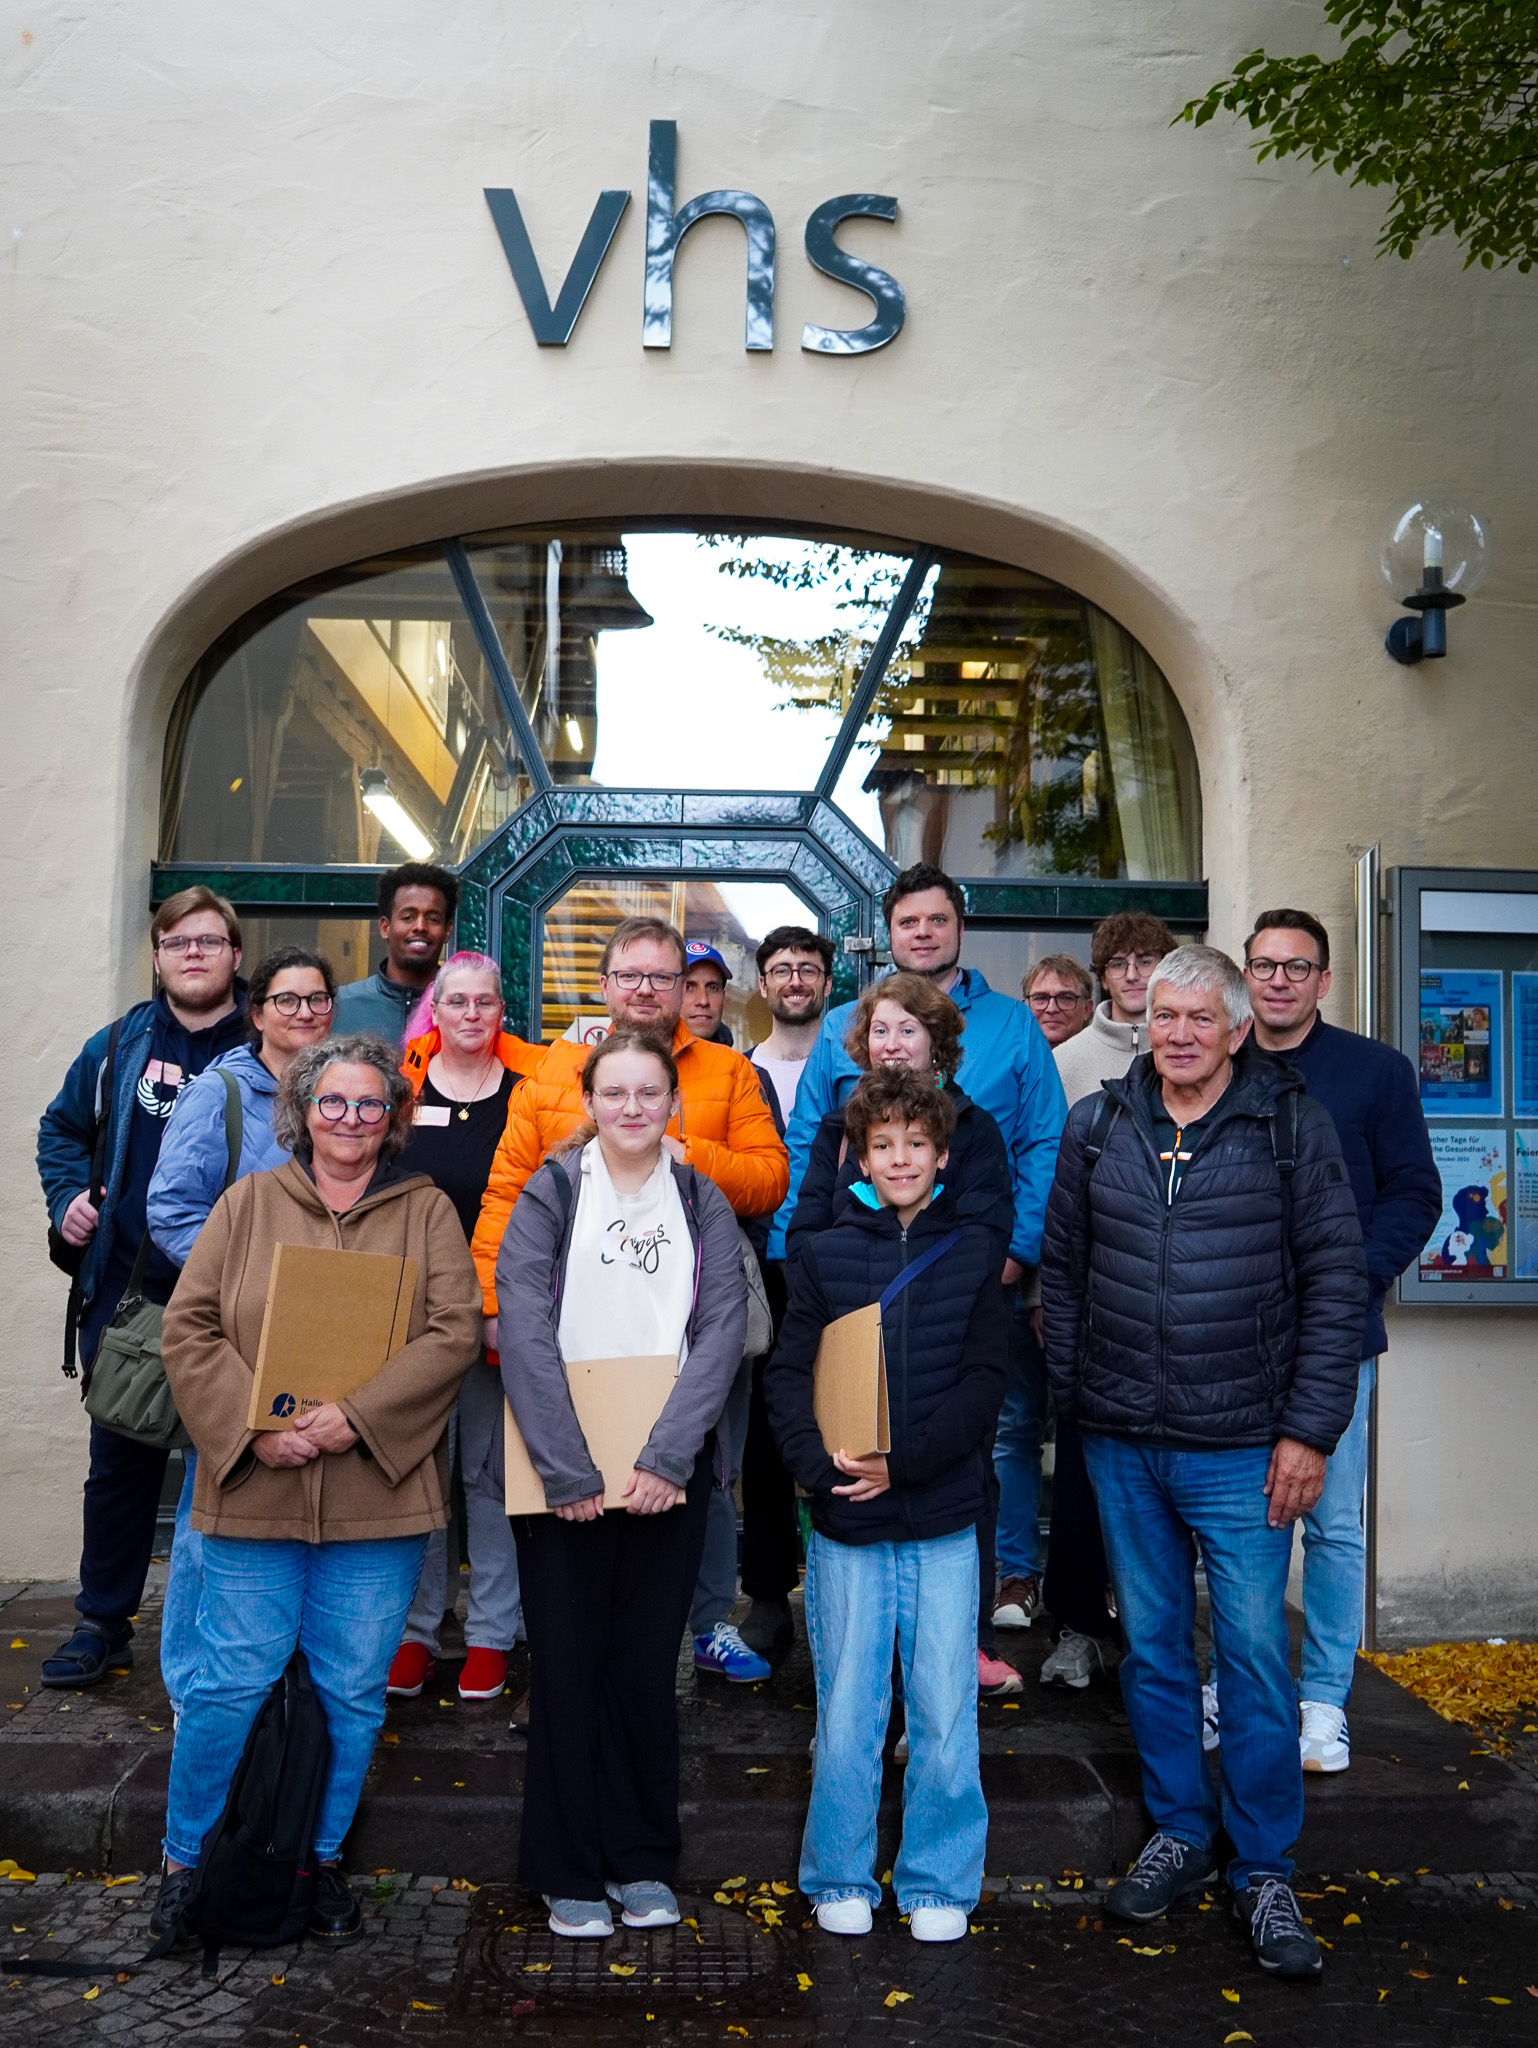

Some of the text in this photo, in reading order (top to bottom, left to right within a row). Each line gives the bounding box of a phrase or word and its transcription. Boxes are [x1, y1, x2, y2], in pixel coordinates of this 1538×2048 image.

[483, 119, 908, 355] vhs
[1450, 1136, 1467, 1145] Tage
[1445, 1145, 1487, 1153] Gesundheit
[301, 1398, 324, 1407] Hallo
